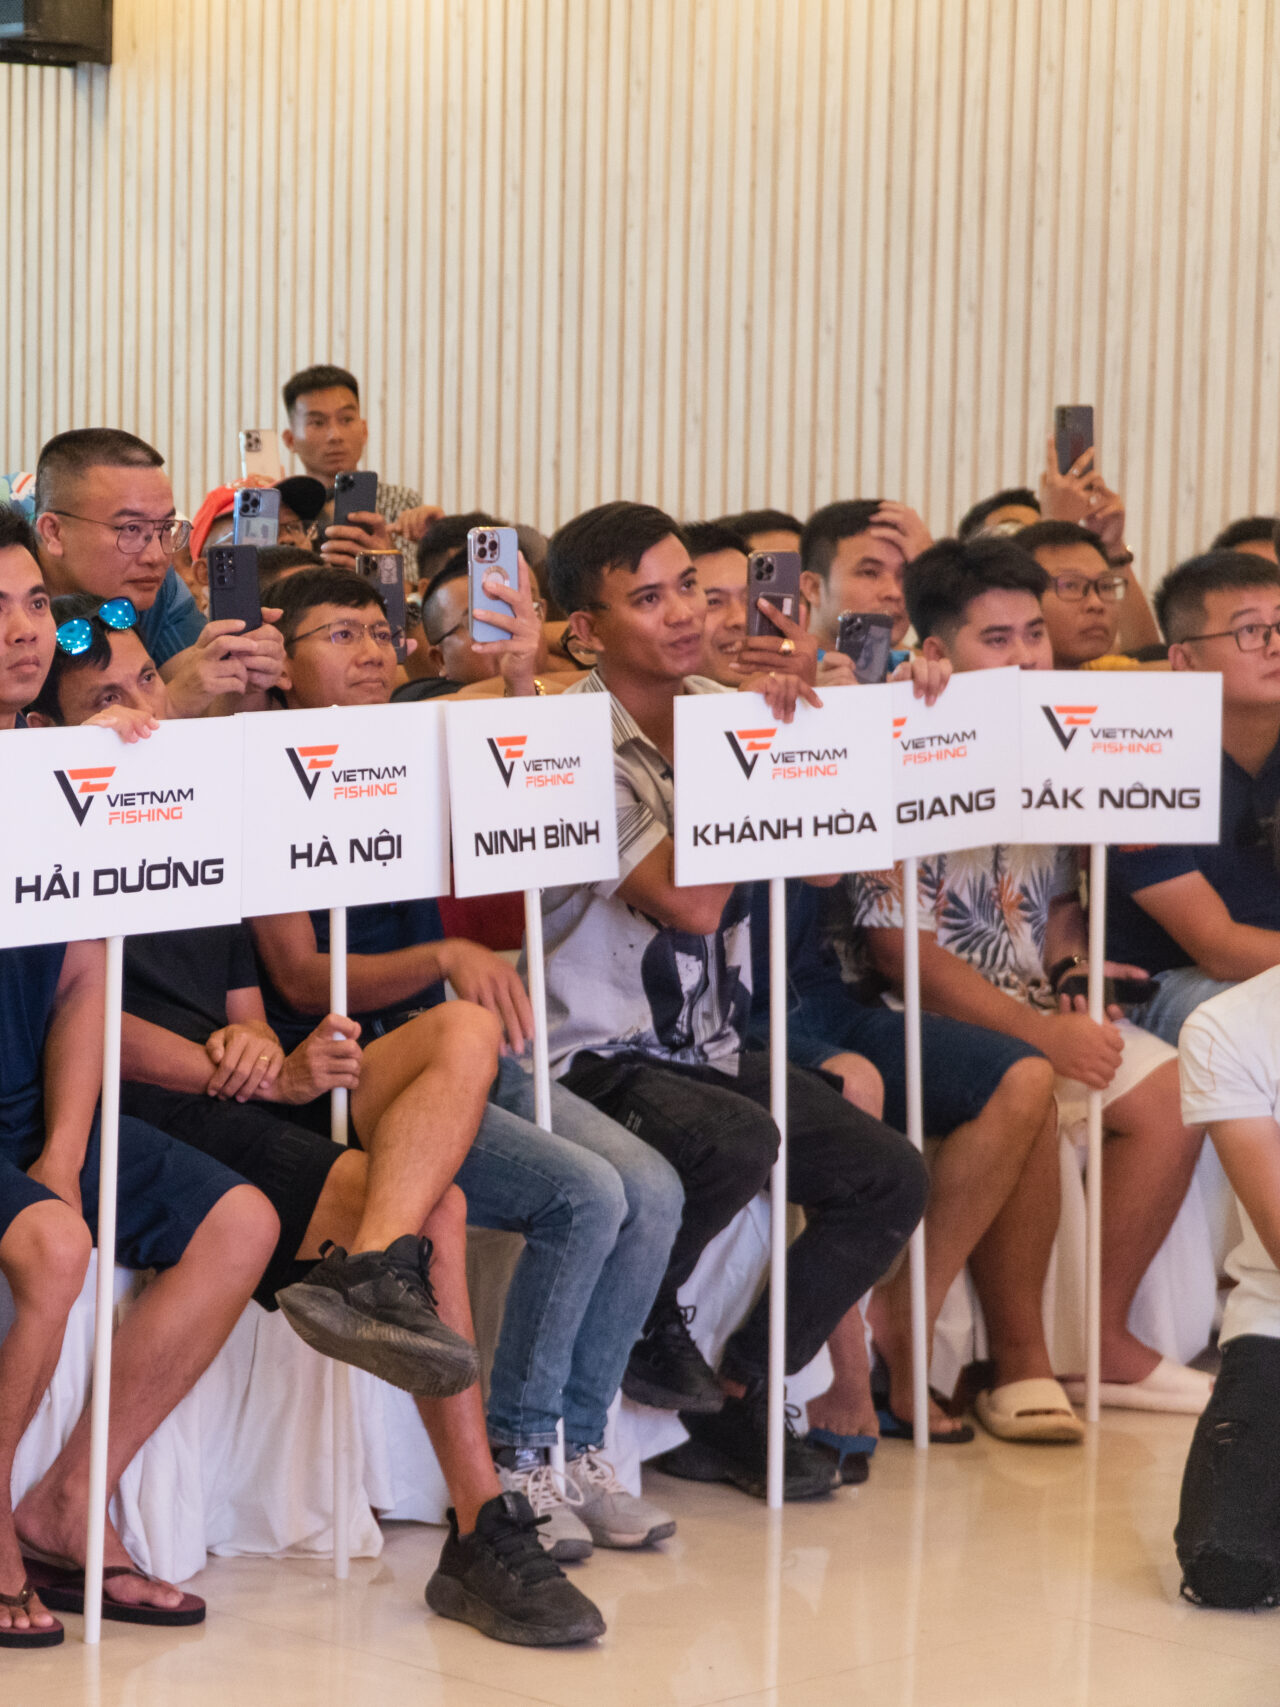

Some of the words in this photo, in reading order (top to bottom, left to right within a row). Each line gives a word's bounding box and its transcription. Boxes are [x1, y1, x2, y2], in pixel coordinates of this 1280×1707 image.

[901, 730, 976, 751] VIETNAM
[1090, 728, 1172, 739] VIETNAM
[770, 748, 847, 764] VIETNAM
[903, 746, 967, 766] FISHING
[1092, 743, 1161, 753] FISHING
[523, 756, 580, 772] VIETNAM
[772, 764, 838, 779] FISHING
[332, 766, 406, 783] VIETNAM
[526, 773, 575, 787] FISHING
[107, 788, 193, 807] VIETNAM
[334, 782, 397, 800] FISHING
[1099, 783, 1200, 809] NÔNG
[109, 806, 182, 824] FISHING
[897, 789, 995, 824] GIANG
[693, 817, 802, 846] KHÁNH
[814, 809, 877, 836] HÒA
[475, 827, 535, 856] NINH
[544, 819, 599, 849] BÌNH
[291, 835, 337, 869] HÀ
[350, 829, 401, 866] NỘI
[16, 864, 79, 903] HẢI
[93, 857, 224, 896] DƯƠNG
